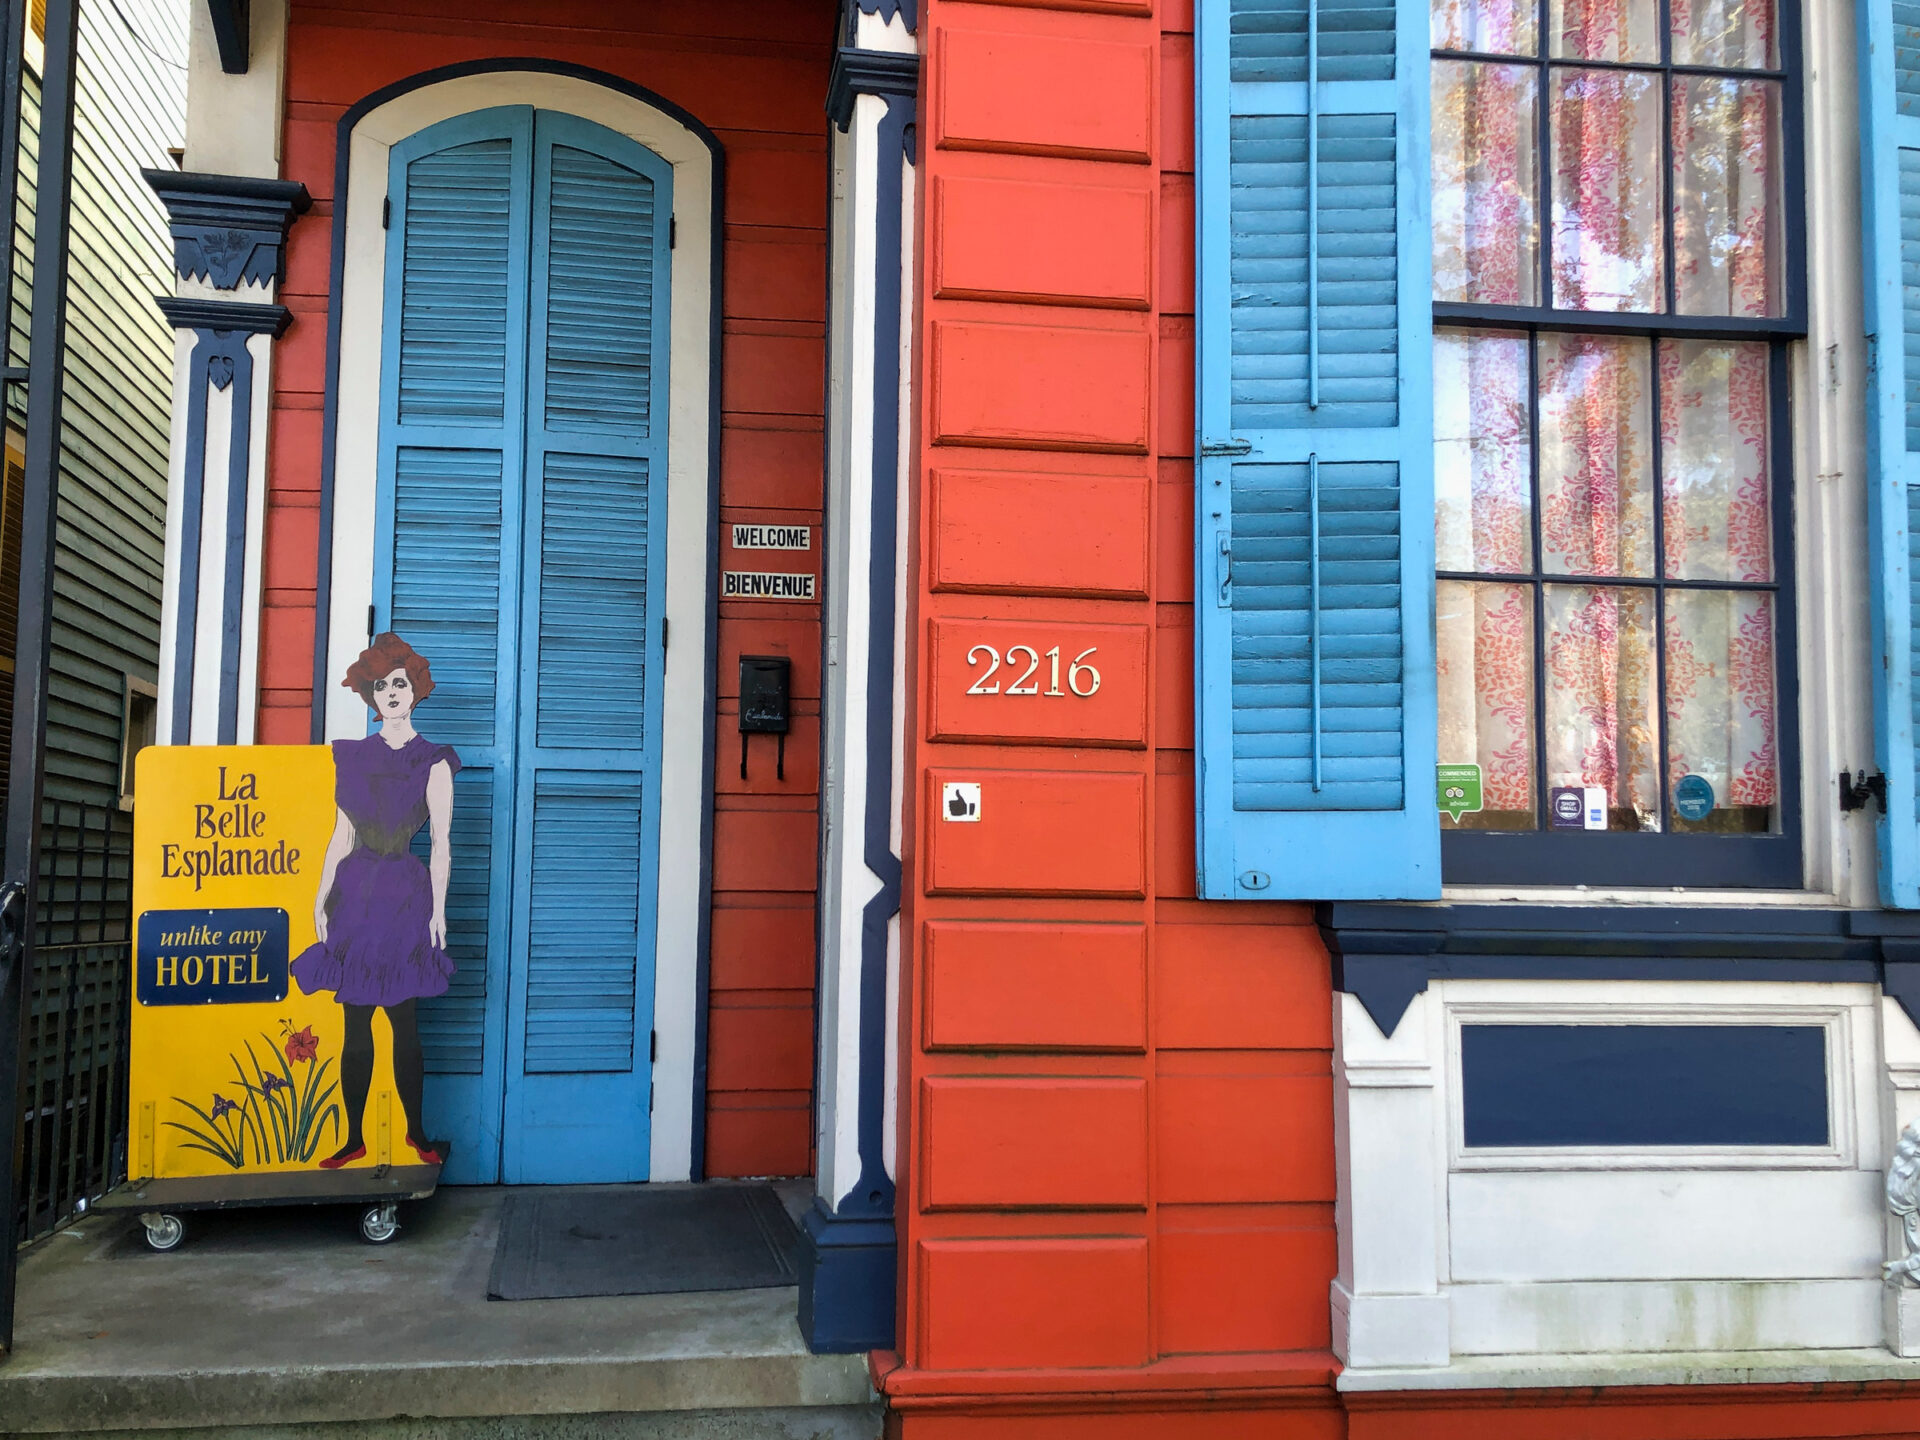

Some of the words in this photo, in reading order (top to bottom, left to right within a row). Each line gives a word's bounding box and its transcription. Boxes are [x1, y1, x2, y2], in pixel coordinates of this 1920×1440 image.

[736, 527, 808, 547] WELCOME
[725, 573, 813, 598] BIENVENUE
[965, 644, 1101, 697] 2216
[217, 766, 258, 801] La
[194, 803, 266, 839] Belle
[160, 840, 301, 892] Esplanade
[160, 925, 222, 947] unlike
[228, 929, 267, 952] any
[155, 954, 270, 987] HOTEL
